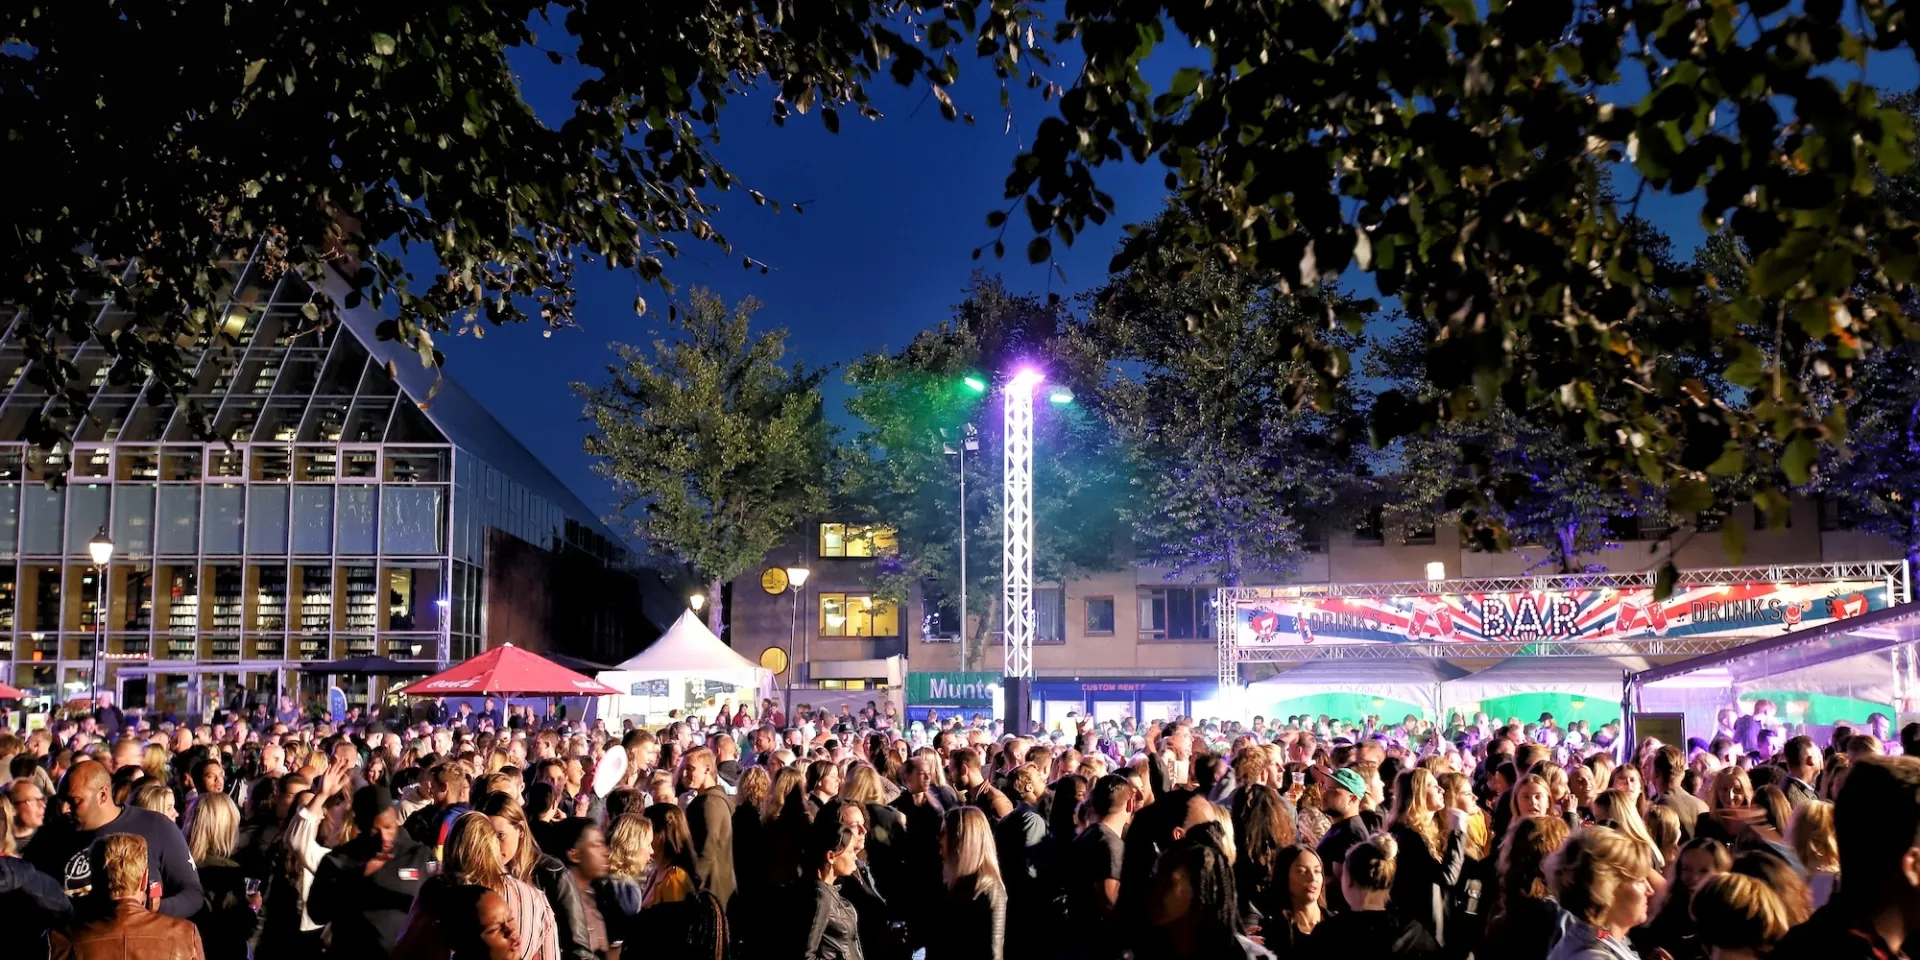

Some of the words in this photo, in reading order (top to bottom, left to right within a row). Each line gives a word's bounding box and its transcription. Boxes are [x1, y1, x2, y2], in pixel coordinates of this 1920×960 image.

[1309, 610, 1382, 633] DRINKS
[1481, 597, 1583, 638] BAR
[1692, 598, 1782, 623] DRINKS
[1081, 683, 1116, 691] CUSTOM
